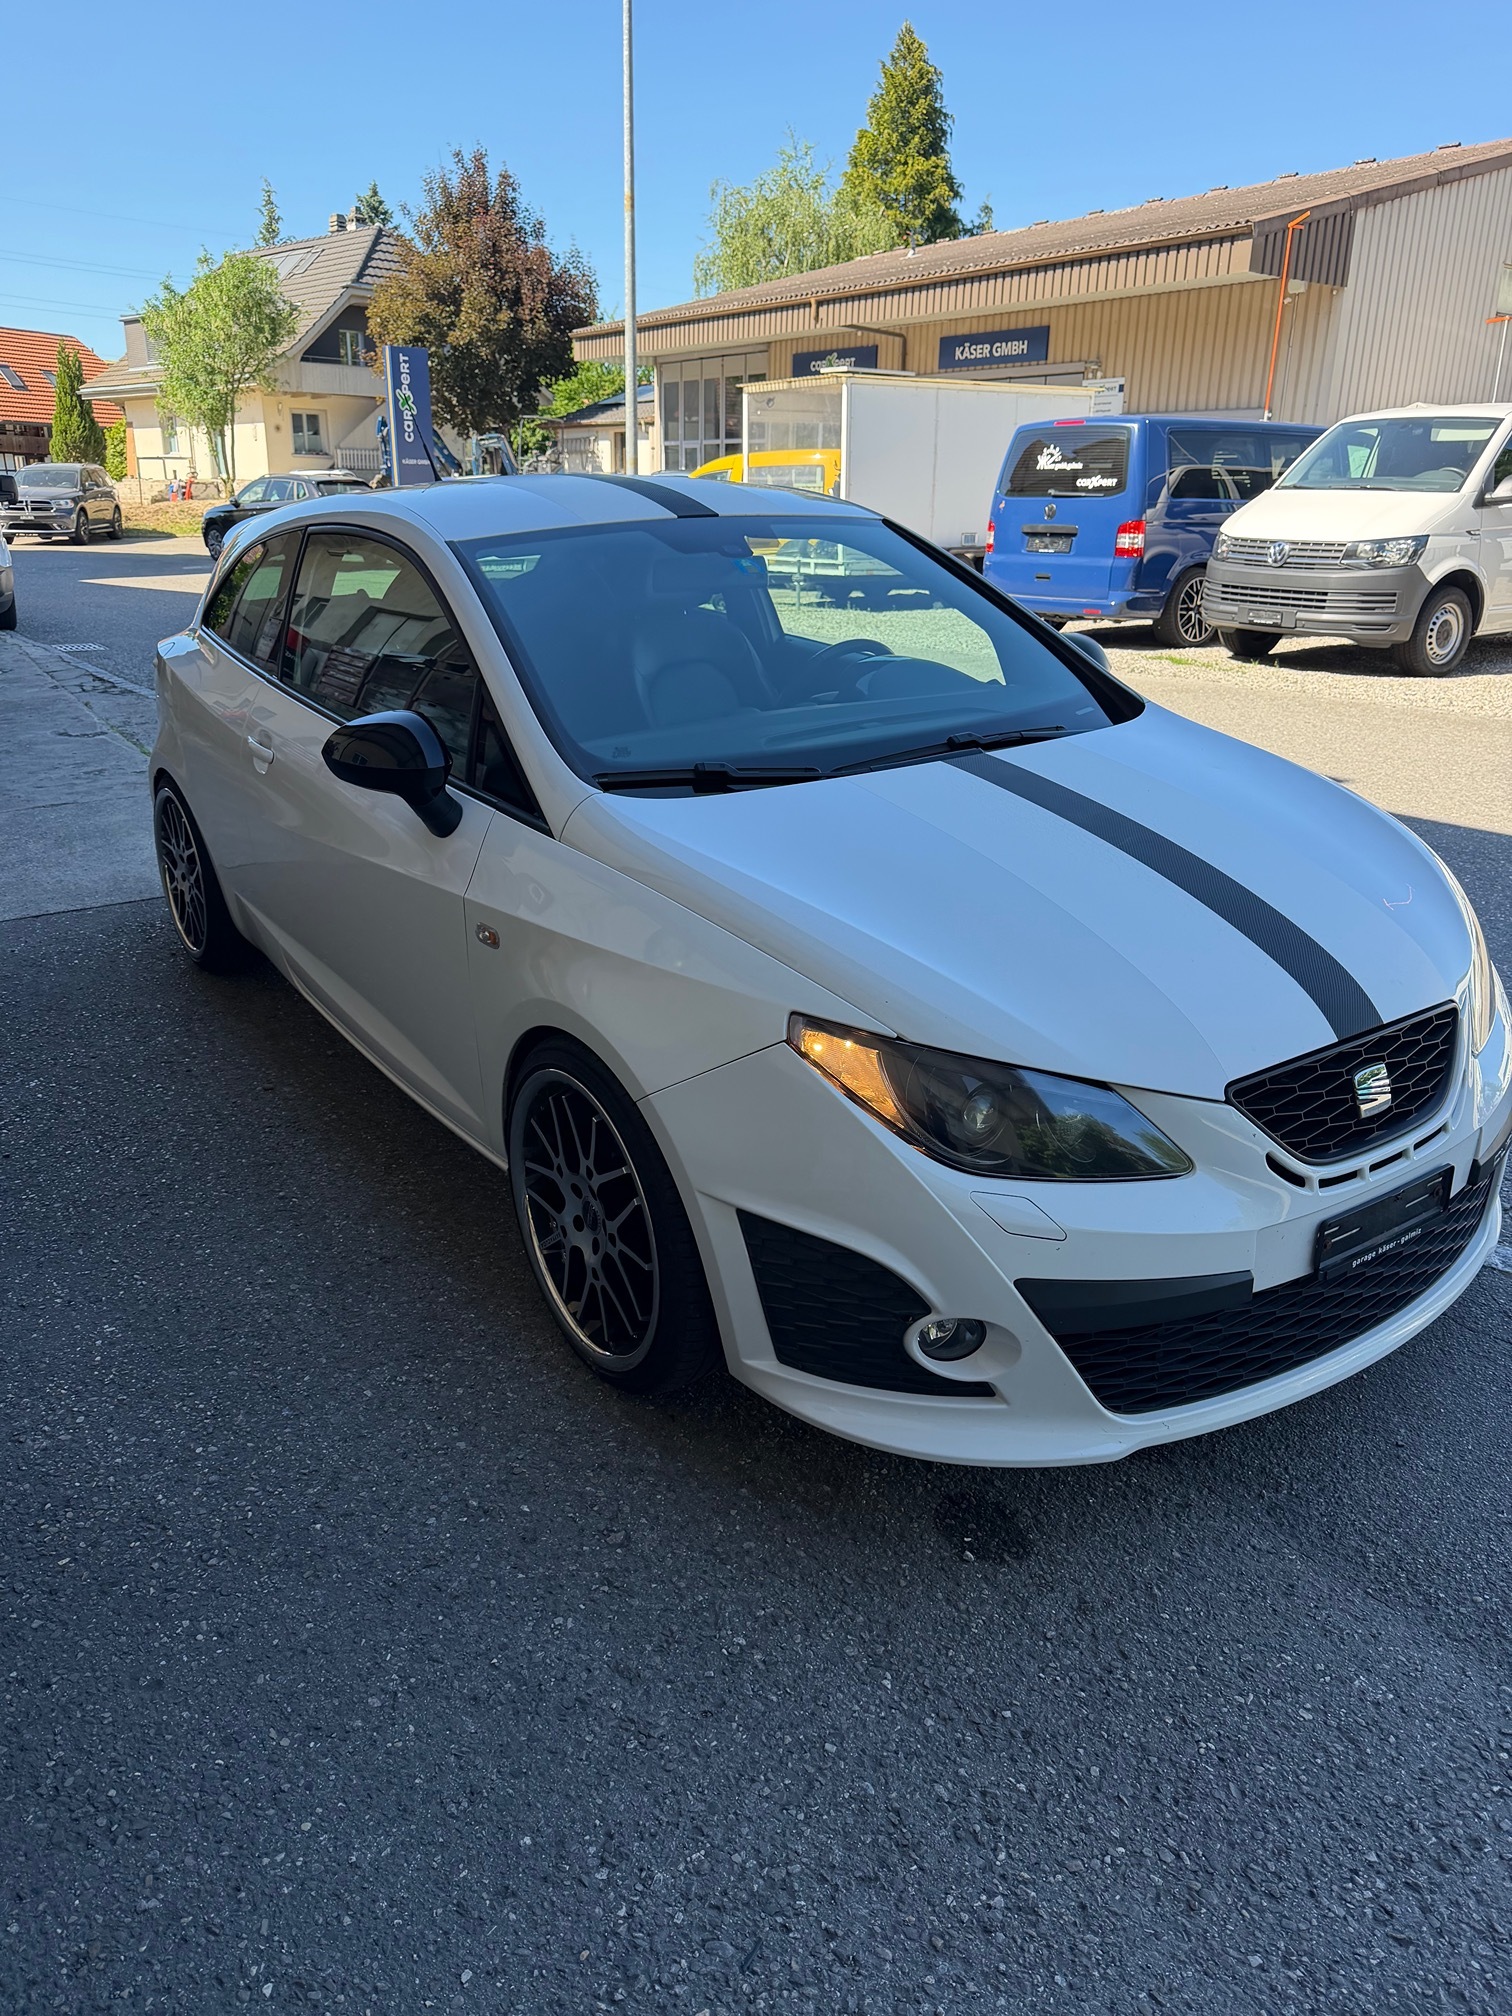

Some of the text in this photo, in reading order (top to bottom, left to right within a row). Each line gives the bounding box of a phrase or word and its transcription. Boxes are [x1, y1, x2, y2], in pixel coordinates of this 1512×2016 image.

[955, 340, 1028, 360] KÄSER GMBH
[1352, 1251, 1376, 1268] garage
